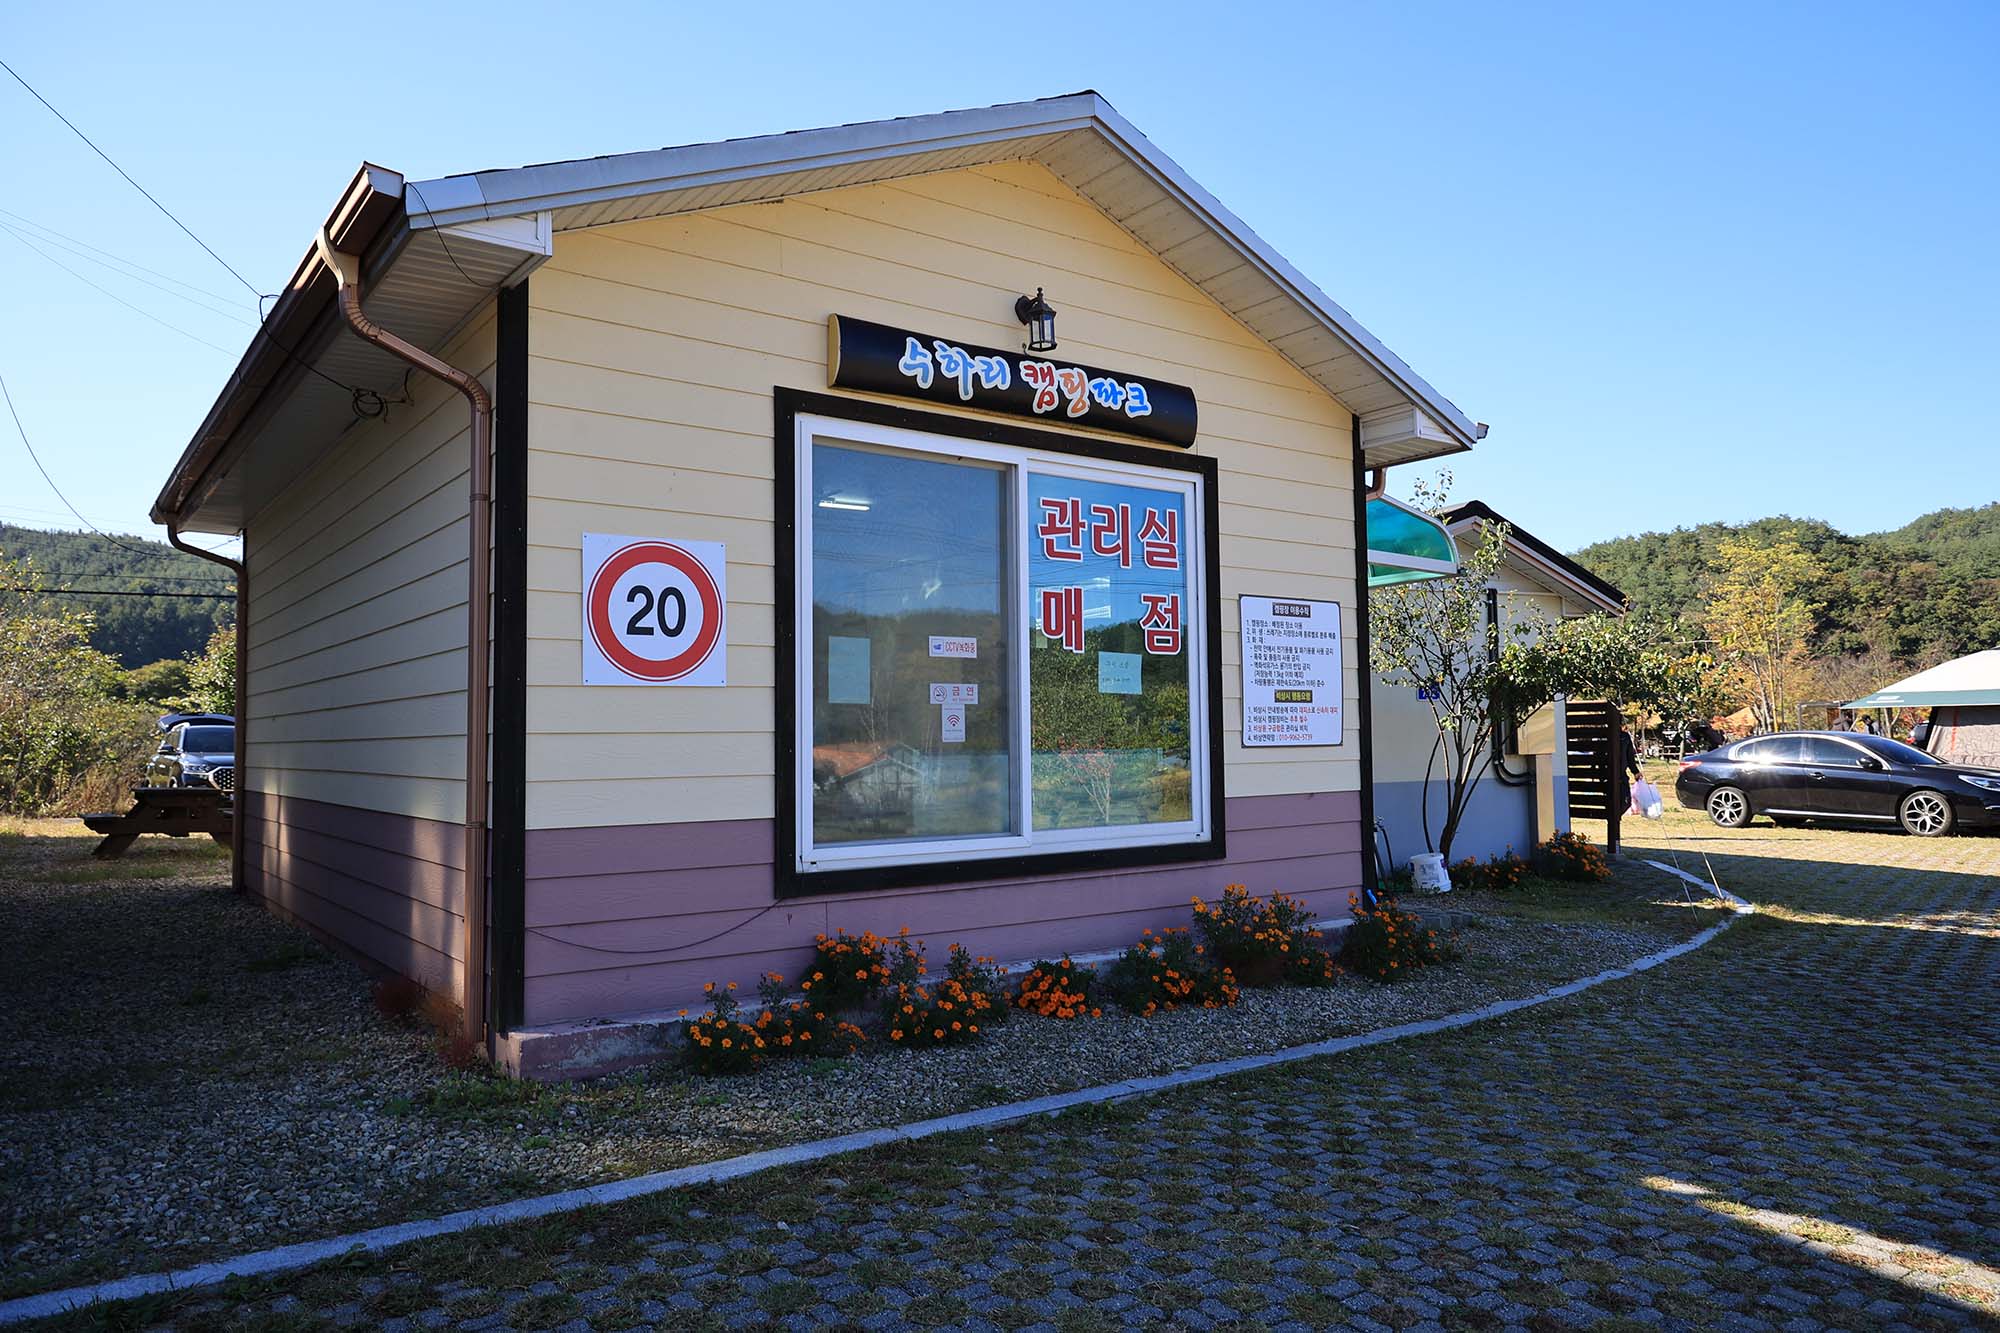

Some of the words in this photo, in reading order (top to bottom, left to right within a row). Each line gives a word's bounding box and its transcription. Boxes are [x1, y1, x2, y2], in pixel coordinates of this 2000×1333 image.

[898, 336, 1011, 400] 수하리
[1020, 361, 1152, 417] 캠핑파크
[1038, 497, 1180, 570] 관리실
[626, 586, 686, 638] 20
